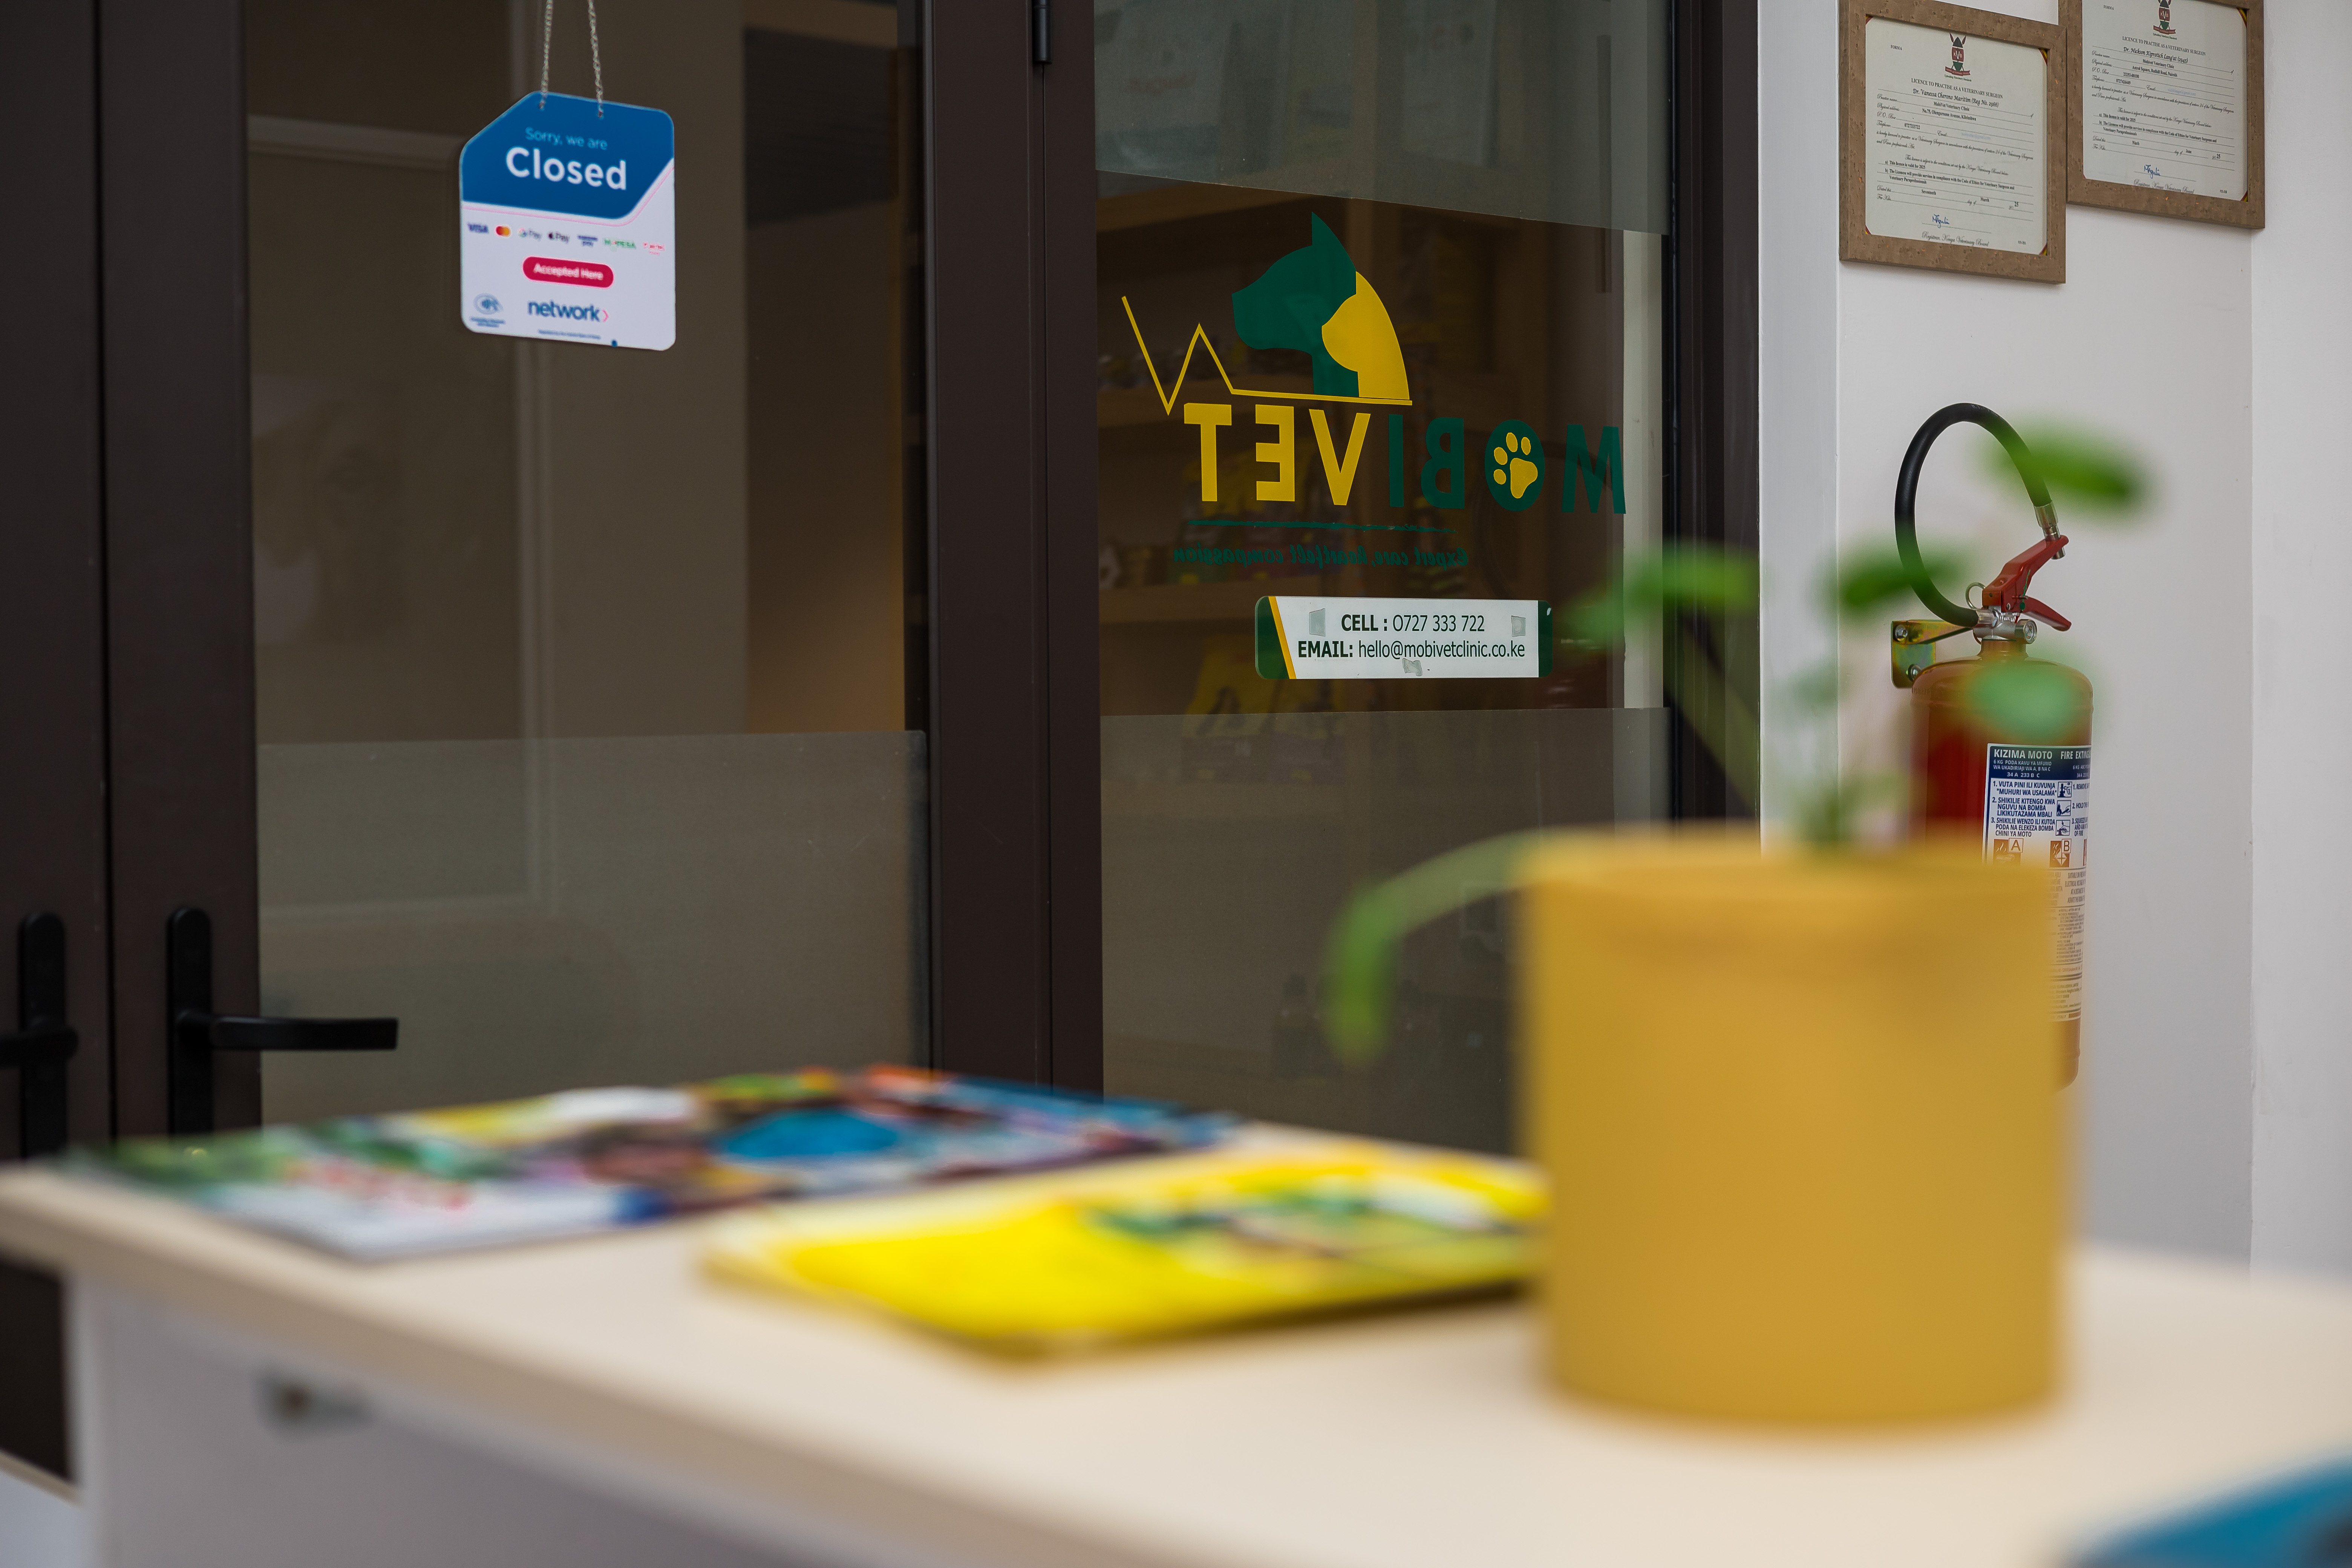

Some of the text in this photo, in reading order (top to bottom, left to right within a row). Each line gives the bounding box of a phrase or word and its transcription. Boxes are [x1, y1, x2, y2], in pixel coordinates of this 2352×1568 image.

[1920, 89, 1937, 97] Vanessa
[1971, 97, 1980, 106] (Reg
[1935, 82, 1952, 90] PRACTISE
[1962, 87, 1985, 96] VETERINARY
[1946, 102, 1960, 111] Veterinary
[525, 126, 608, 150] Sorry, we are
[505, 145, 627, 191] Closed
[533, 263, 603, 280] Accepted Here
[528, 299, 601, 322] network
[1341, 614, 1379, 632] CELL
[1432, 615, 1456, 632] 333
[1461, 615, 1485, 632] 722
[1298, 640, 1526, 660] EMAIL: hello@mobivetclinic.co.ke
[1994, 749, 2053, 760] KIZIMA MOTO
[2060, 751, 2073, 760] FIRE
[2011, 839, 2021, 851] A
[2063, 840, 2070, 851] B
